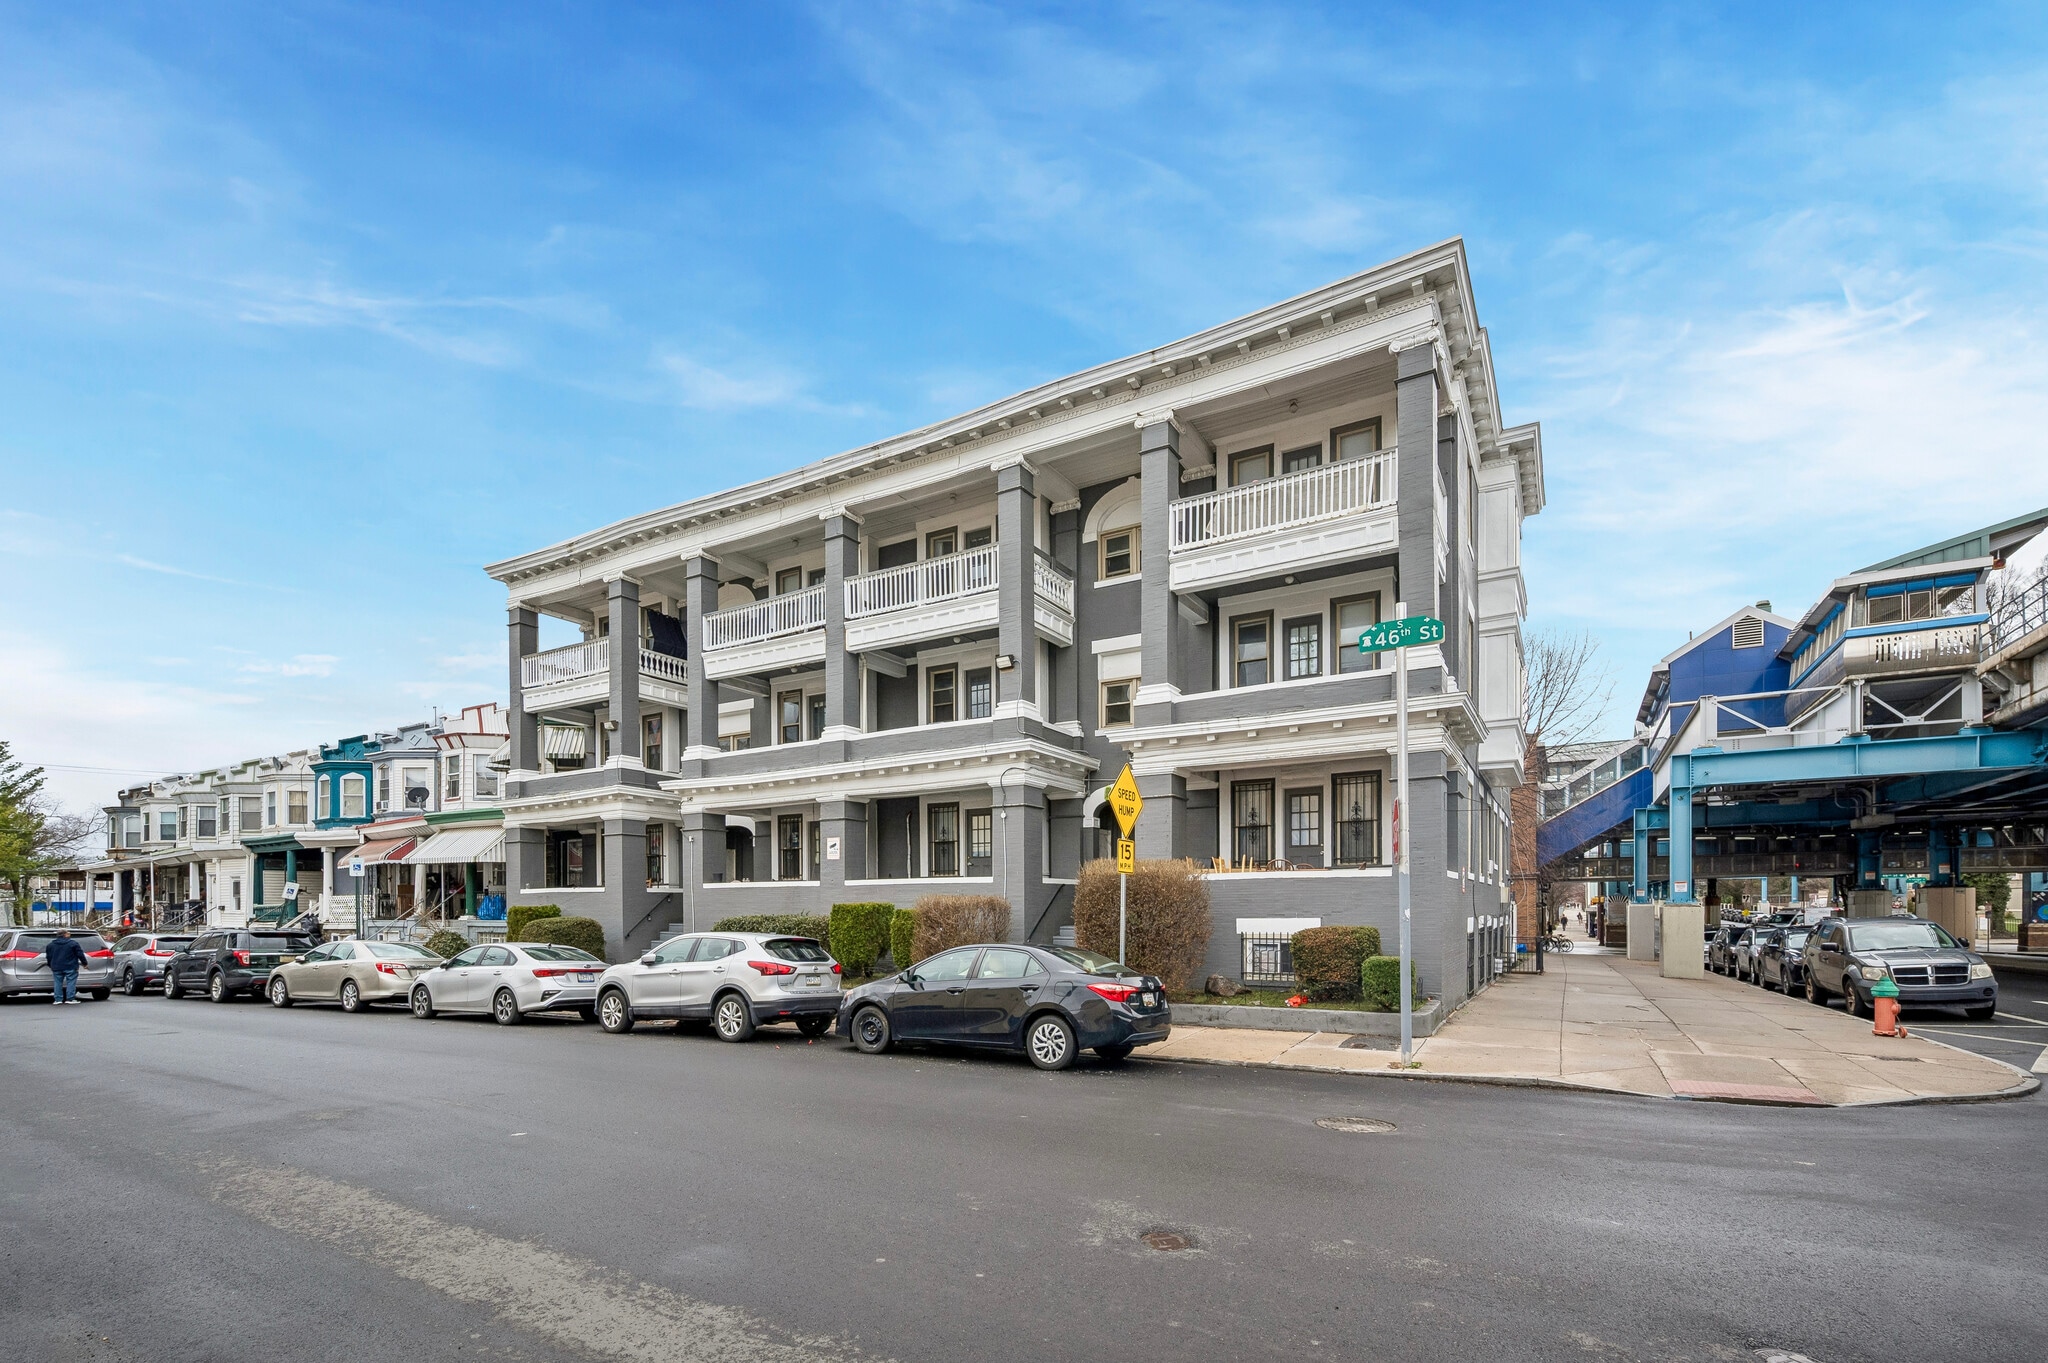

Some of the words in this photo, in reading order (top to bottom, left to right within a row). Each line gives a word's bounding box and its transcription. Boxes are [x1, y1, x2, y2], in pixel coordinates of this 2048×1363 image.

[1397, 620, 1404, 629] S
[1375, 627, 1410, 646] 46th
[1419, 625, 1438, 639] St
[1117, 788, 1135, 801] SPEED
[1118, 805, 1134, 817] HUMP
[1120, 843, 1131, 860] 15
